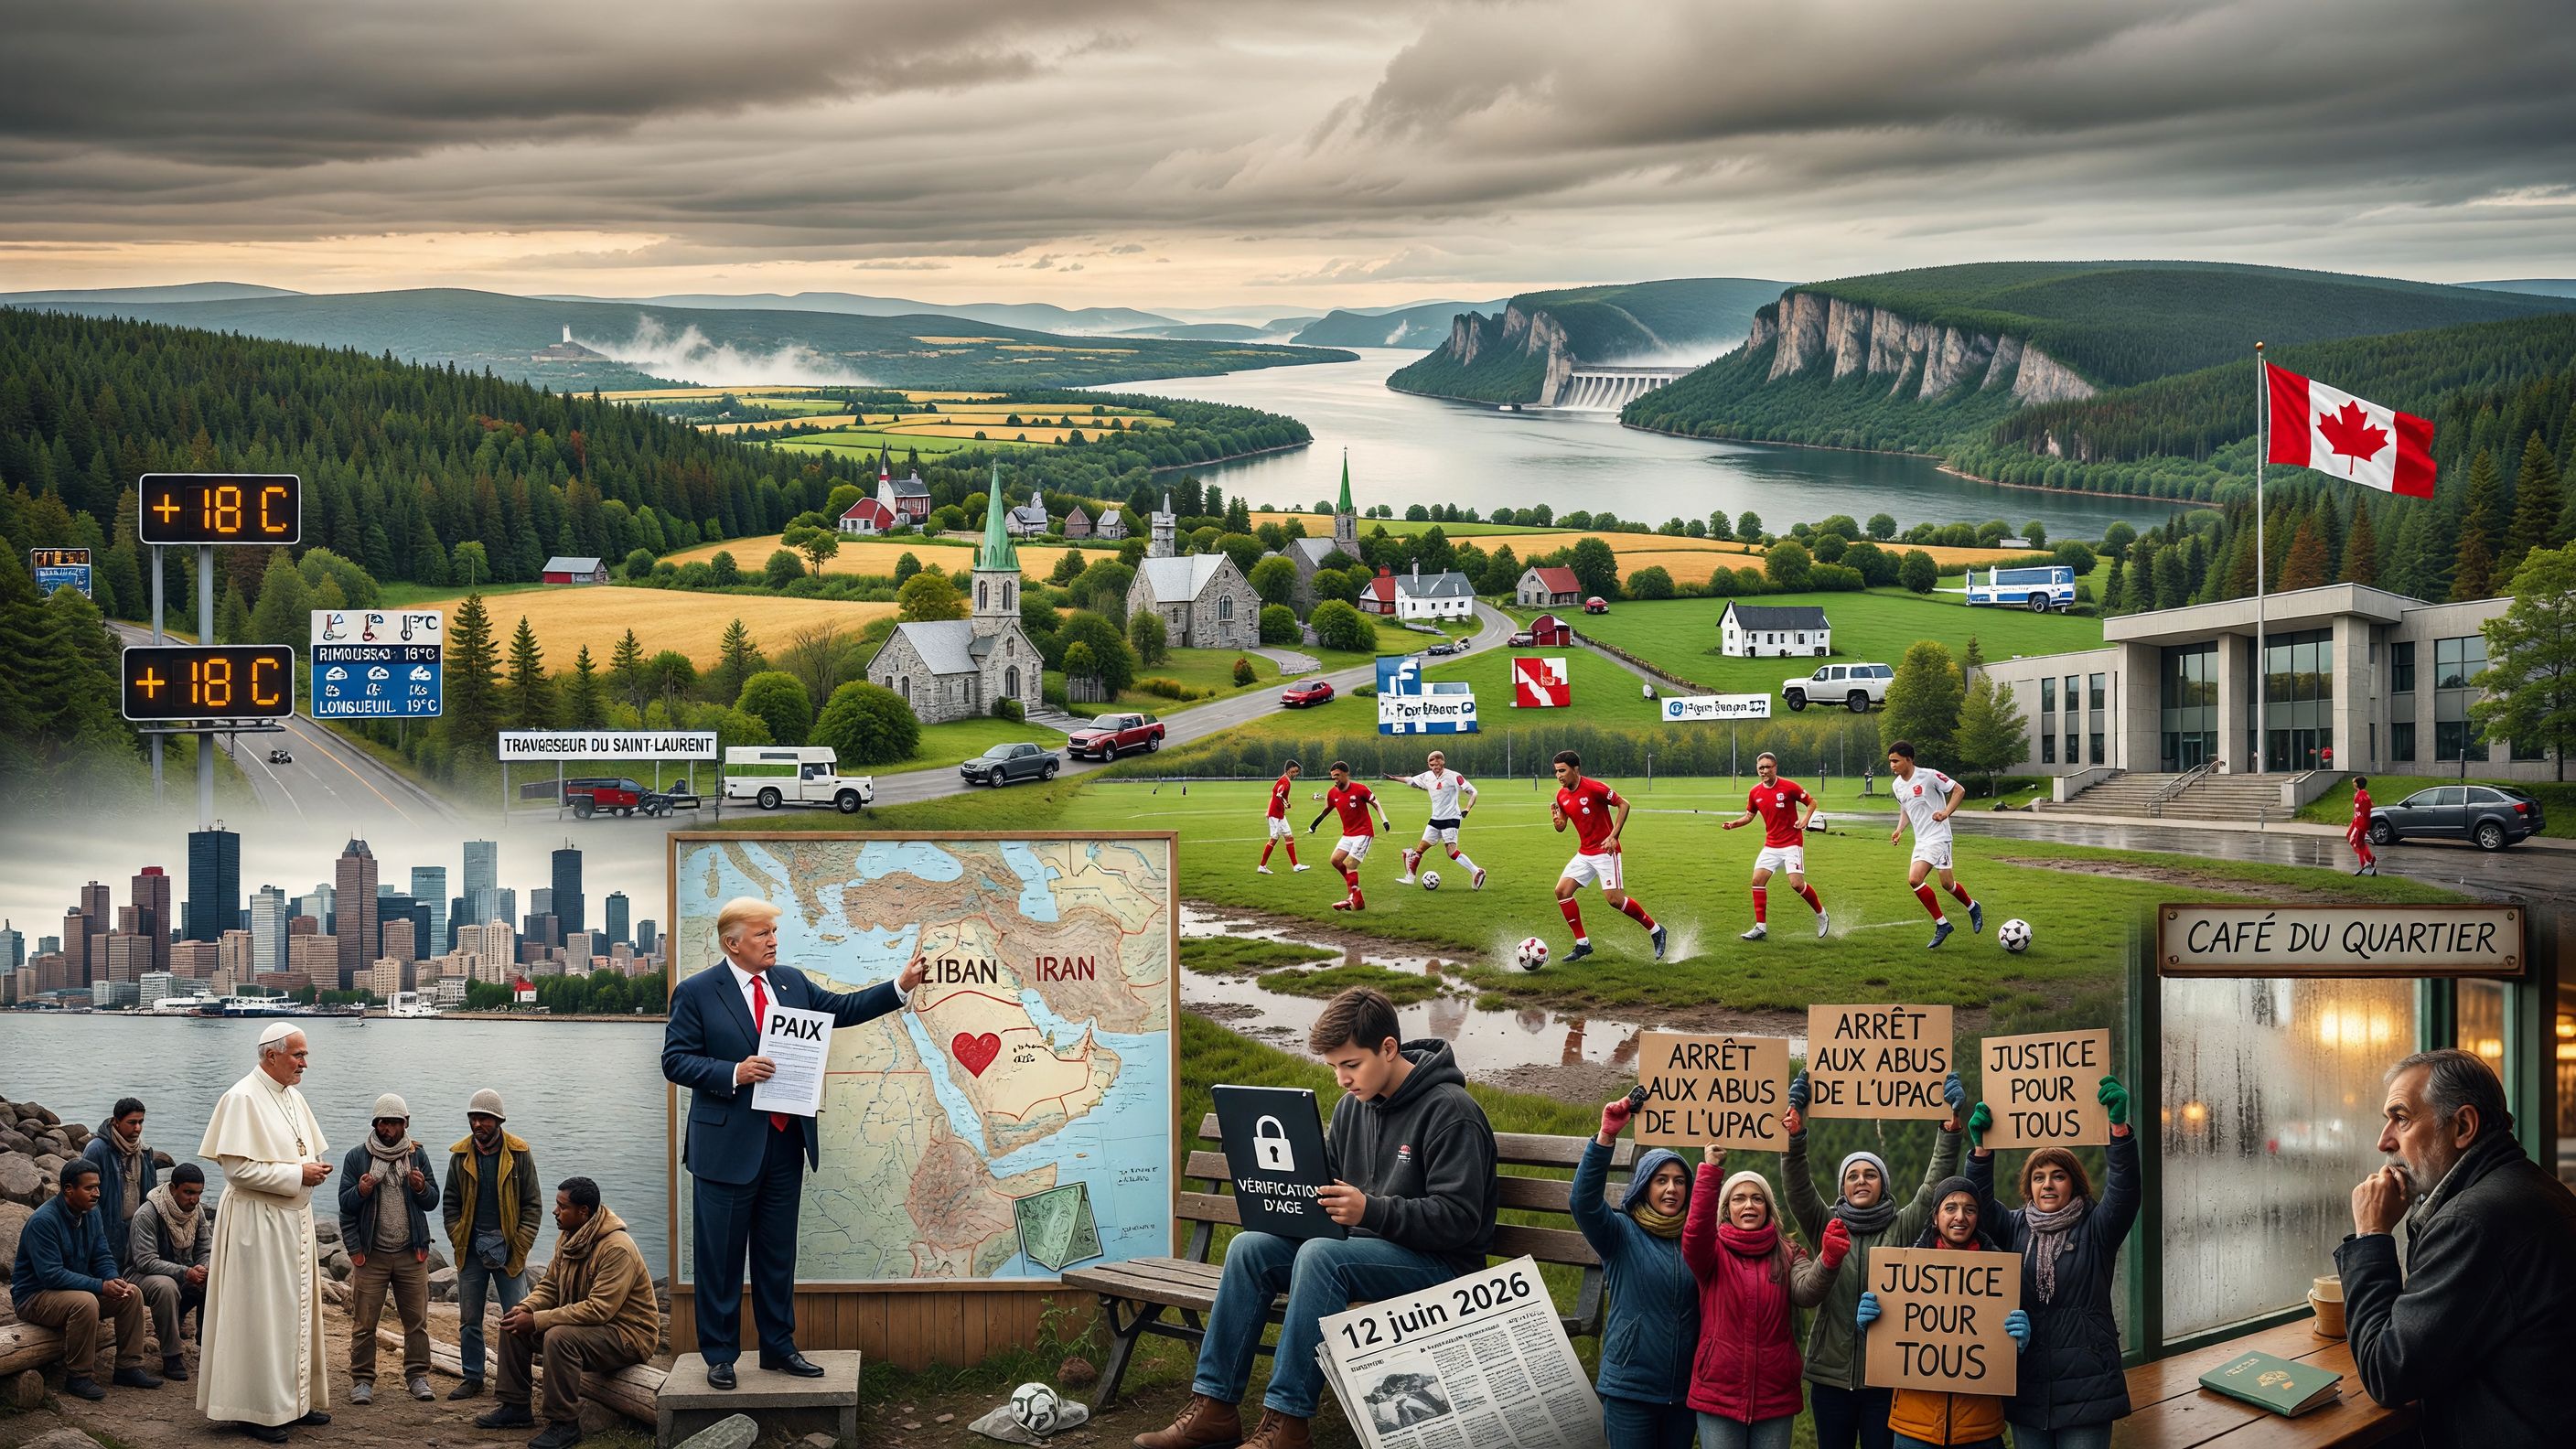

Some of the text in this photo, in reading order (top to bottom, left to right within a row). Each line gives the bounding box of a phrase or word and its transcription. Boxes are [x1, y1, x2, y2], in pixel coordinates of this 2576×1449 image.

[319, 699, 438, 714] LONGUEUIL 19°C
[591, 738, 609, 752] DU
[613, 737, 714, 753] SAINT-LAURENT
[2187, 912, 2497, 960] CAFÉ DU QUARTIER
[1035, 956, 1096, 982] IRAN
[769, 1014, 824, 1042] PAIX
[1834, 1006, 1927, 1040] ARRÊT
[1668, 1037, 1757, 1071] ARRÊT
[1814, 1047, 1947, 1074] AUX ABUS
[1990, 1039, 2097, 1073] JUSTICE
[1648, 1076, 1776, 1104] AUX ABUS
[1814, 1079, 1944, 1107] DE L'UPAC
[2011, 1076, 2077, 1104] POUR
[1645, 1109, 1775, 1139] DE L'UPAC
[2008, 1109, 2081, 1139] TOUS
[1263, 1198, 1304, 1215] D'AGE
[1881, 1262, 2003, 1297] JUSTICE
[1341, 1317, 1383, 1349] 12
[1386, 1303, 1449, 1344] juin
[1452, 1272, 1531, 1317] 2026
[1904, 1302, 1978, 1336] POUR
[1895, 1341, 1987, 1380] TOUS
